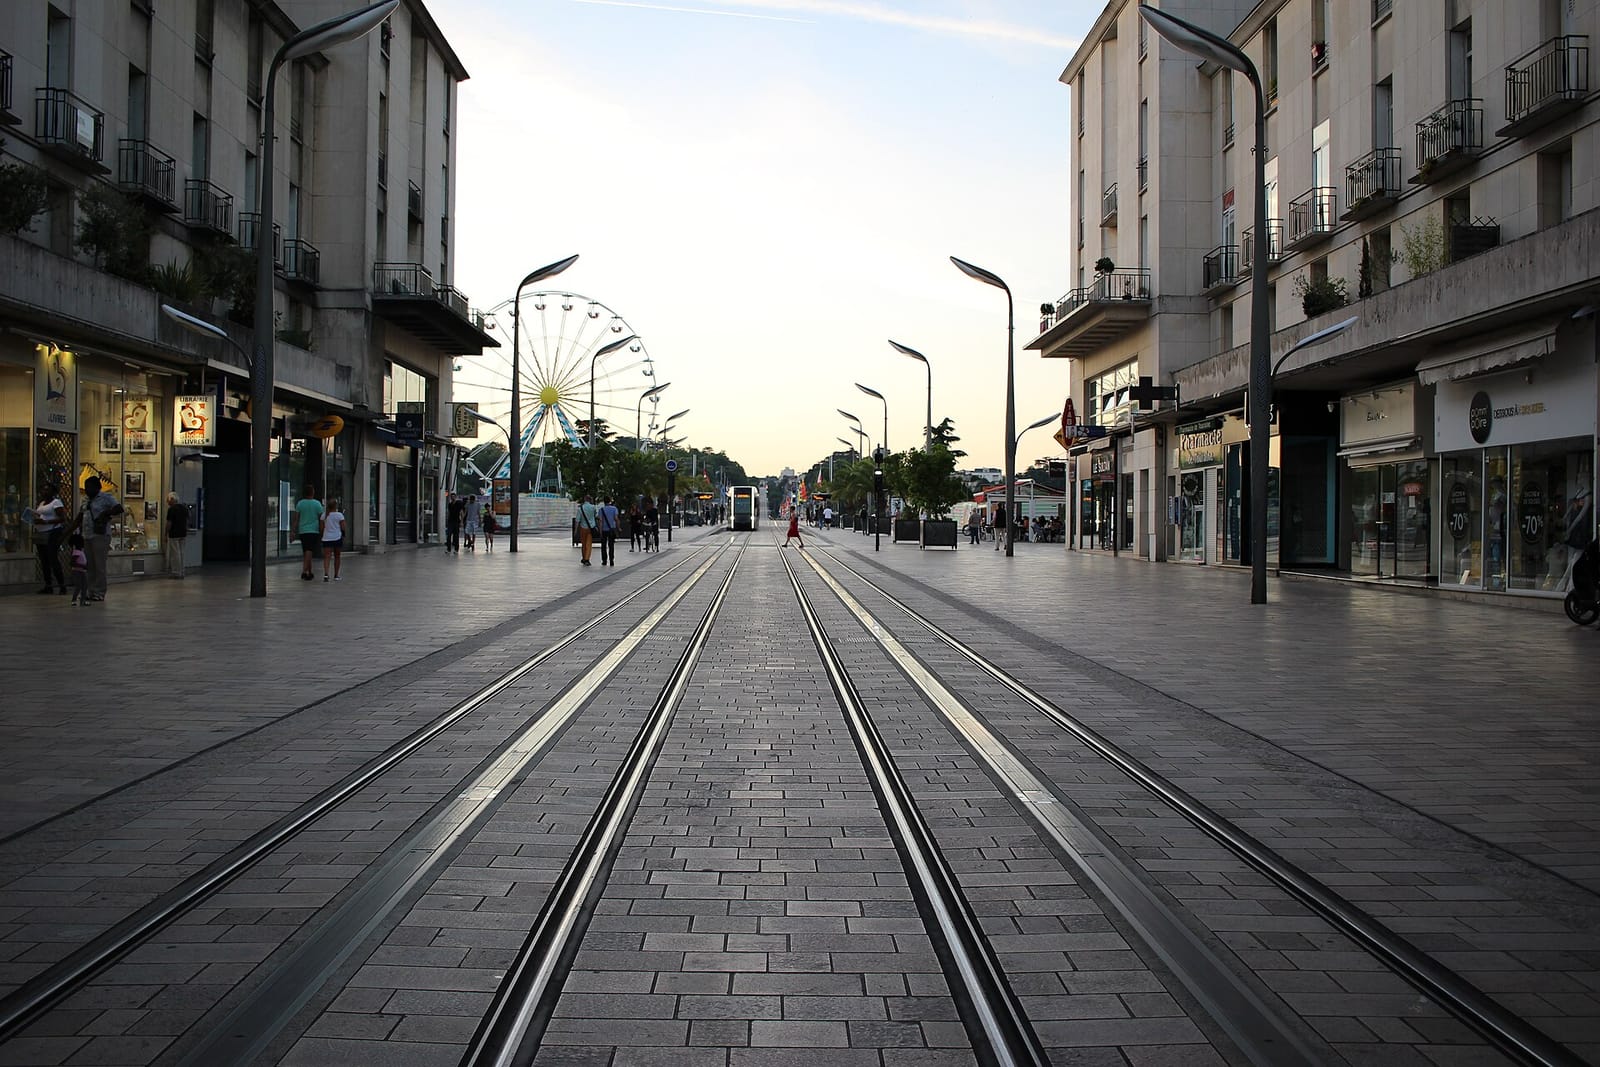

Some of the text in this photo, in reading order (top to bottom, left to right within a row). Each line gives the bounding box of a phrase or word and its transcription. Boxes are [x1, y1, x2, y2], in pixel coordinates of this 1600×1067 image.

[1493, 407, 1514, 419] DESSOUS
[1180, 429, 1223, 451] Pharmacie
[1450, 513, 1468, 531] -70%
[1522, 515, 1544, 535] -70%
